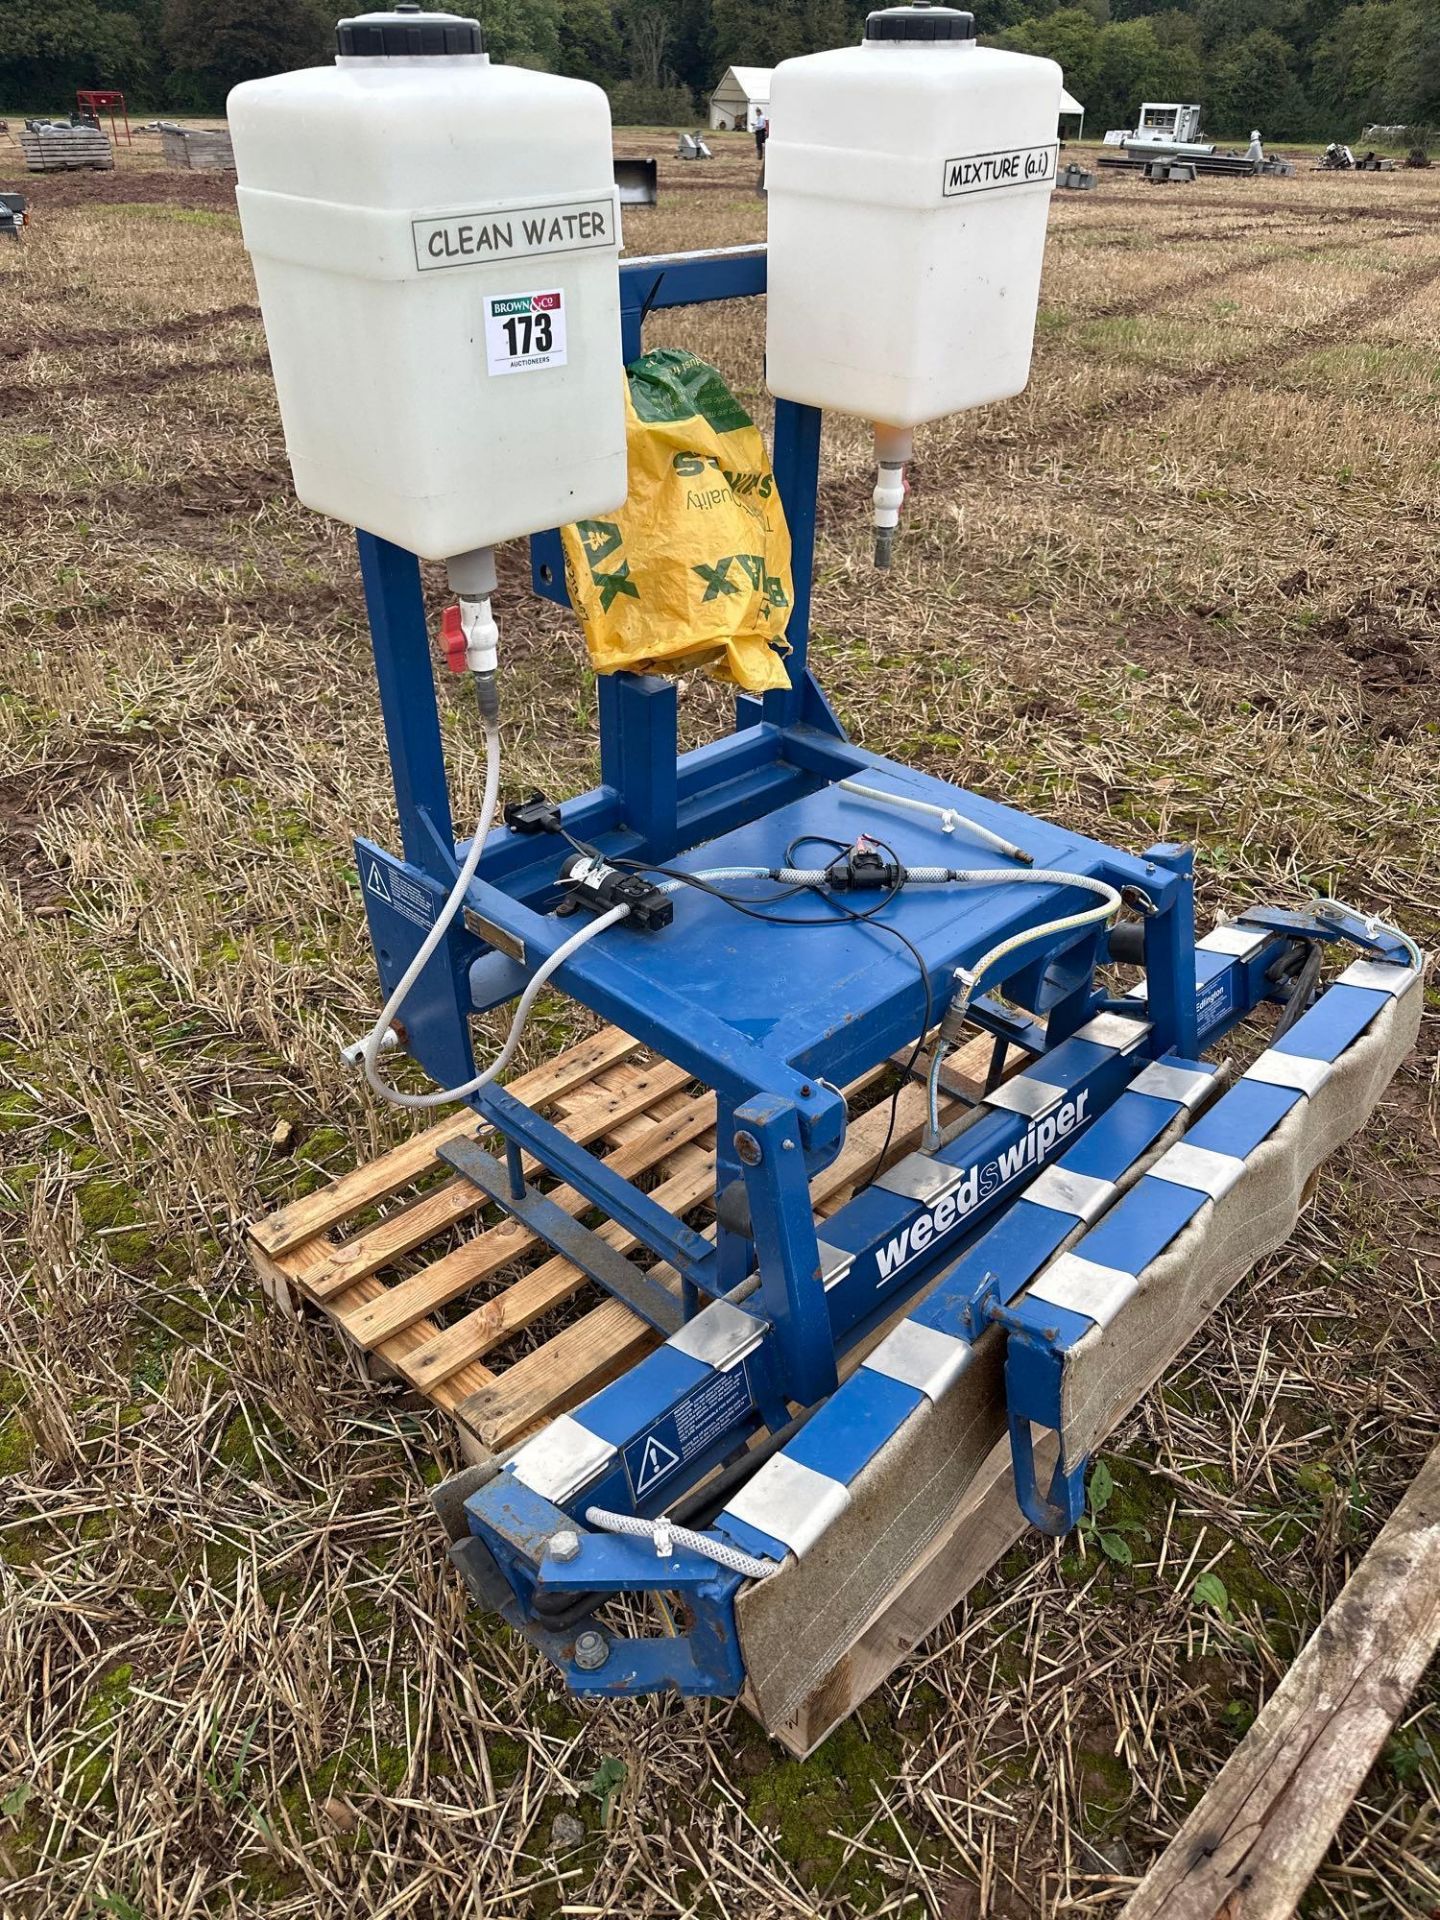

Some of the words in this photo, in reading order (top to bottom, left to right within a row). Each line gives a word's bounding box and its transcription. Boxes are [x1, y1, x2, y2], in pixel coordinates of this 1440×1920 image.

[949, 155, 1021, 187] MIXTURE
[428, 222, 513, 257] CLEAN
[522, 211, 606, 246] WATER
[502, 313, 553, 356] 173
[510, 357, 550, 368] AUCTIONEERS
[875, 1088, 1089, 1279] weedswiper
